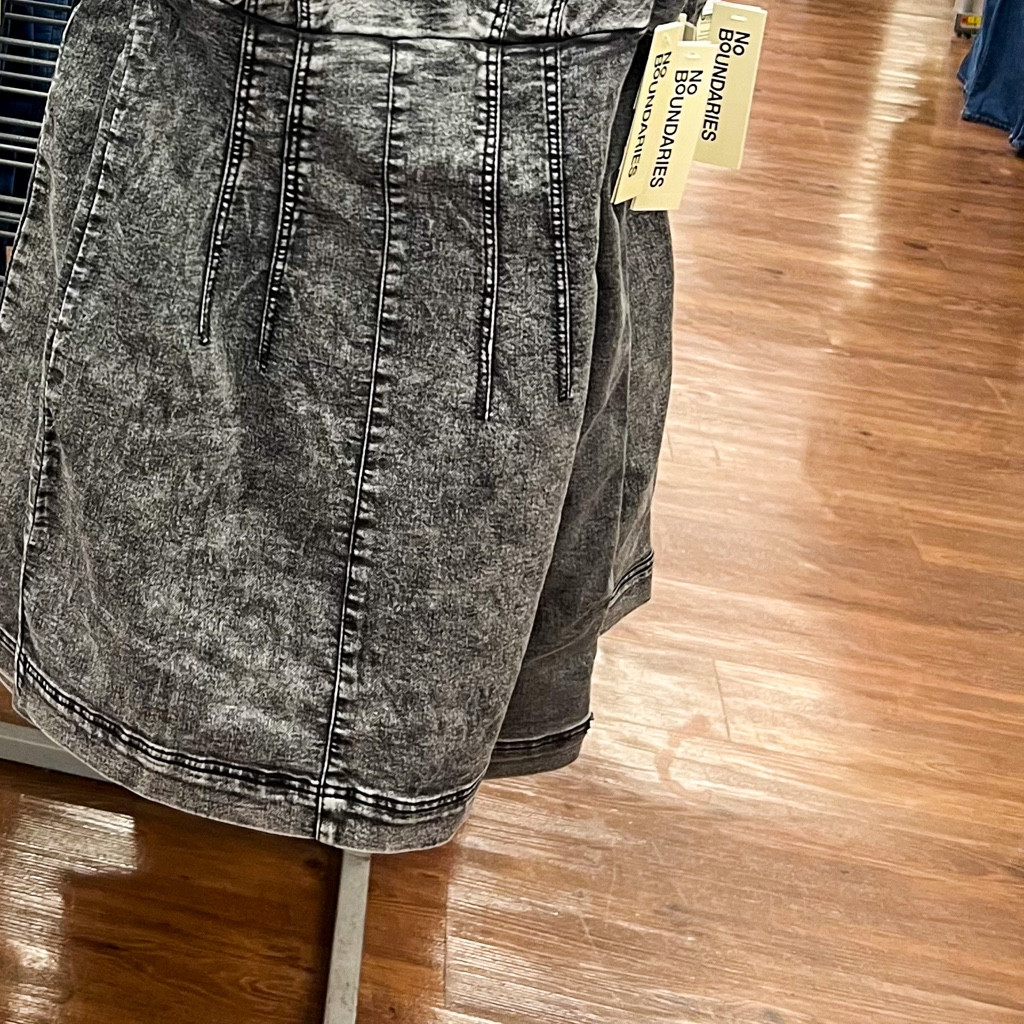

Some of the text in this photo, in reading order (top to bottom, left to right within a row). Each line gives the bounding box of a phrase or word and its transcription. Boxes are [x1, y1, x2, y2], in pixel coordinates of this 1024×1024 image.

[658, 51, 673, 78] NO
[732, 31, 751, 57] NO
[627, 53, 666, 178] BOUNDARIES
[687, 70, 704, 95] NO
[701, 28, 734, 142] BOUNDARIES
[649, 69, 689, 188] BOUNDARIES
